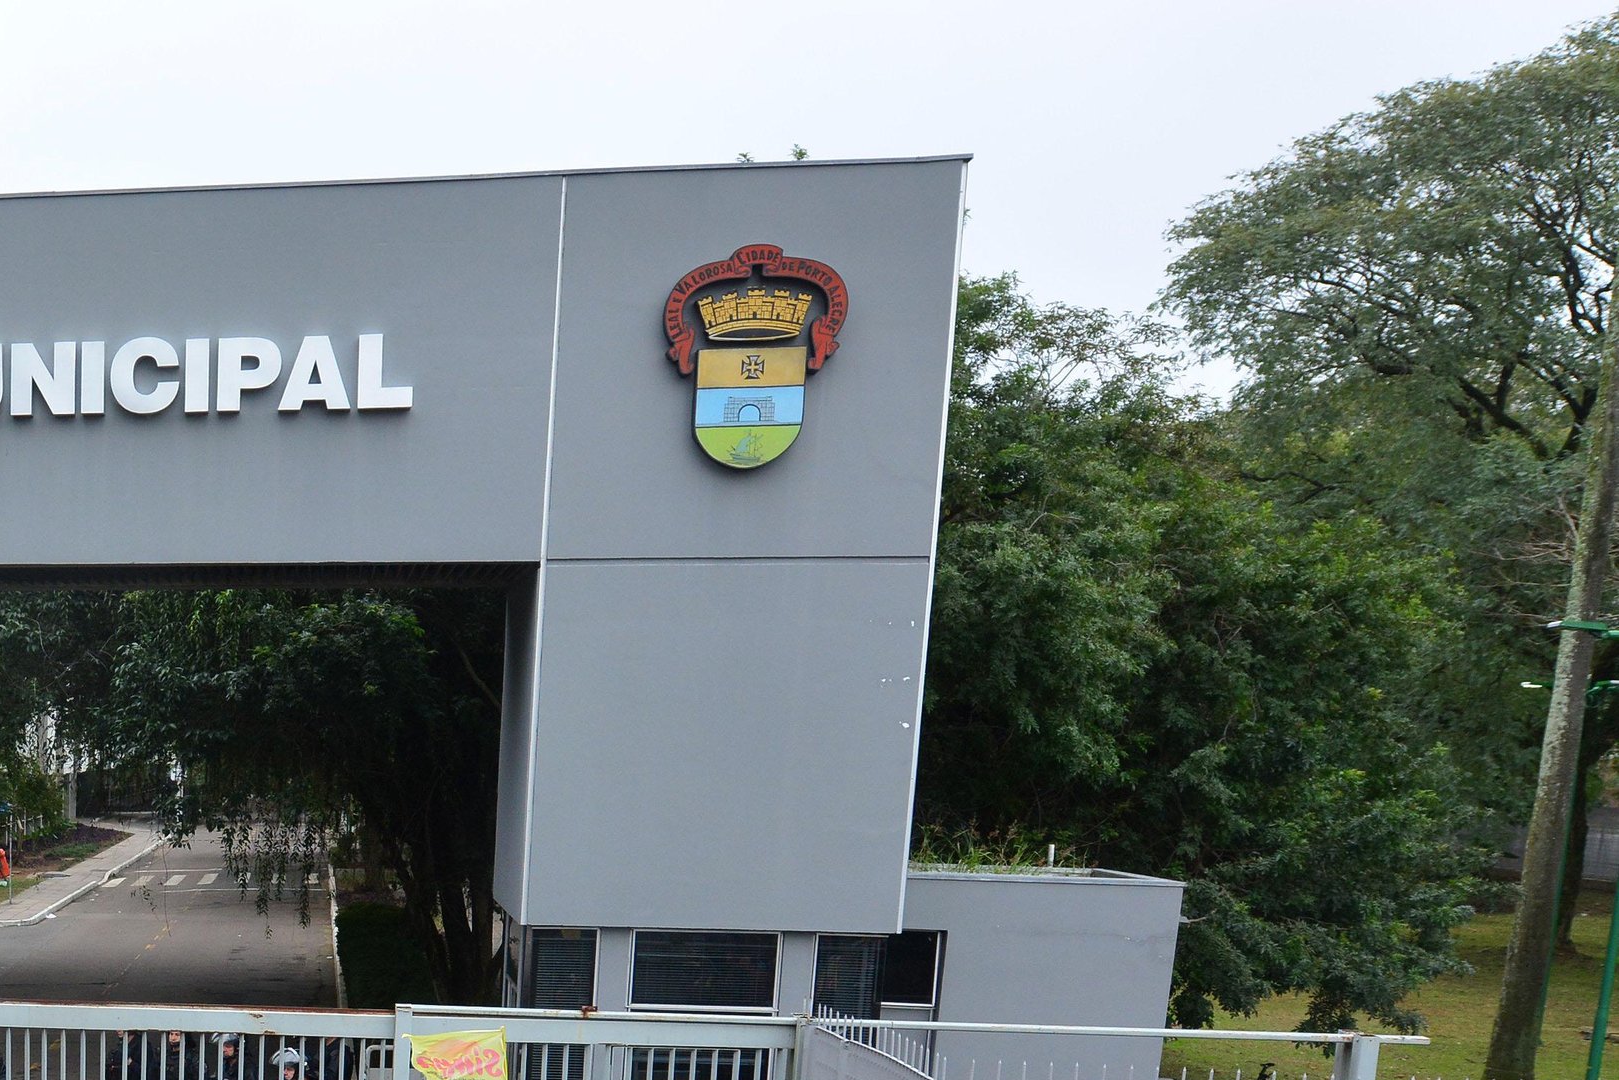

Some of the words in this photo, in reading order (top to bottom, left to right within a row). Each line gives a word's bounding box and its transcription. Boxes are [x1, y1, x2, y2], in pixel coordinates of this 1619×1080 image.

[736, 249, 779, 265] CIDADE
[782, 262, 794, 270] DE
[674, 263, 732, 295] VALOROSA
[797, 261, 832, 285] PORTO
[668, 308, 684, 339] LEAL
